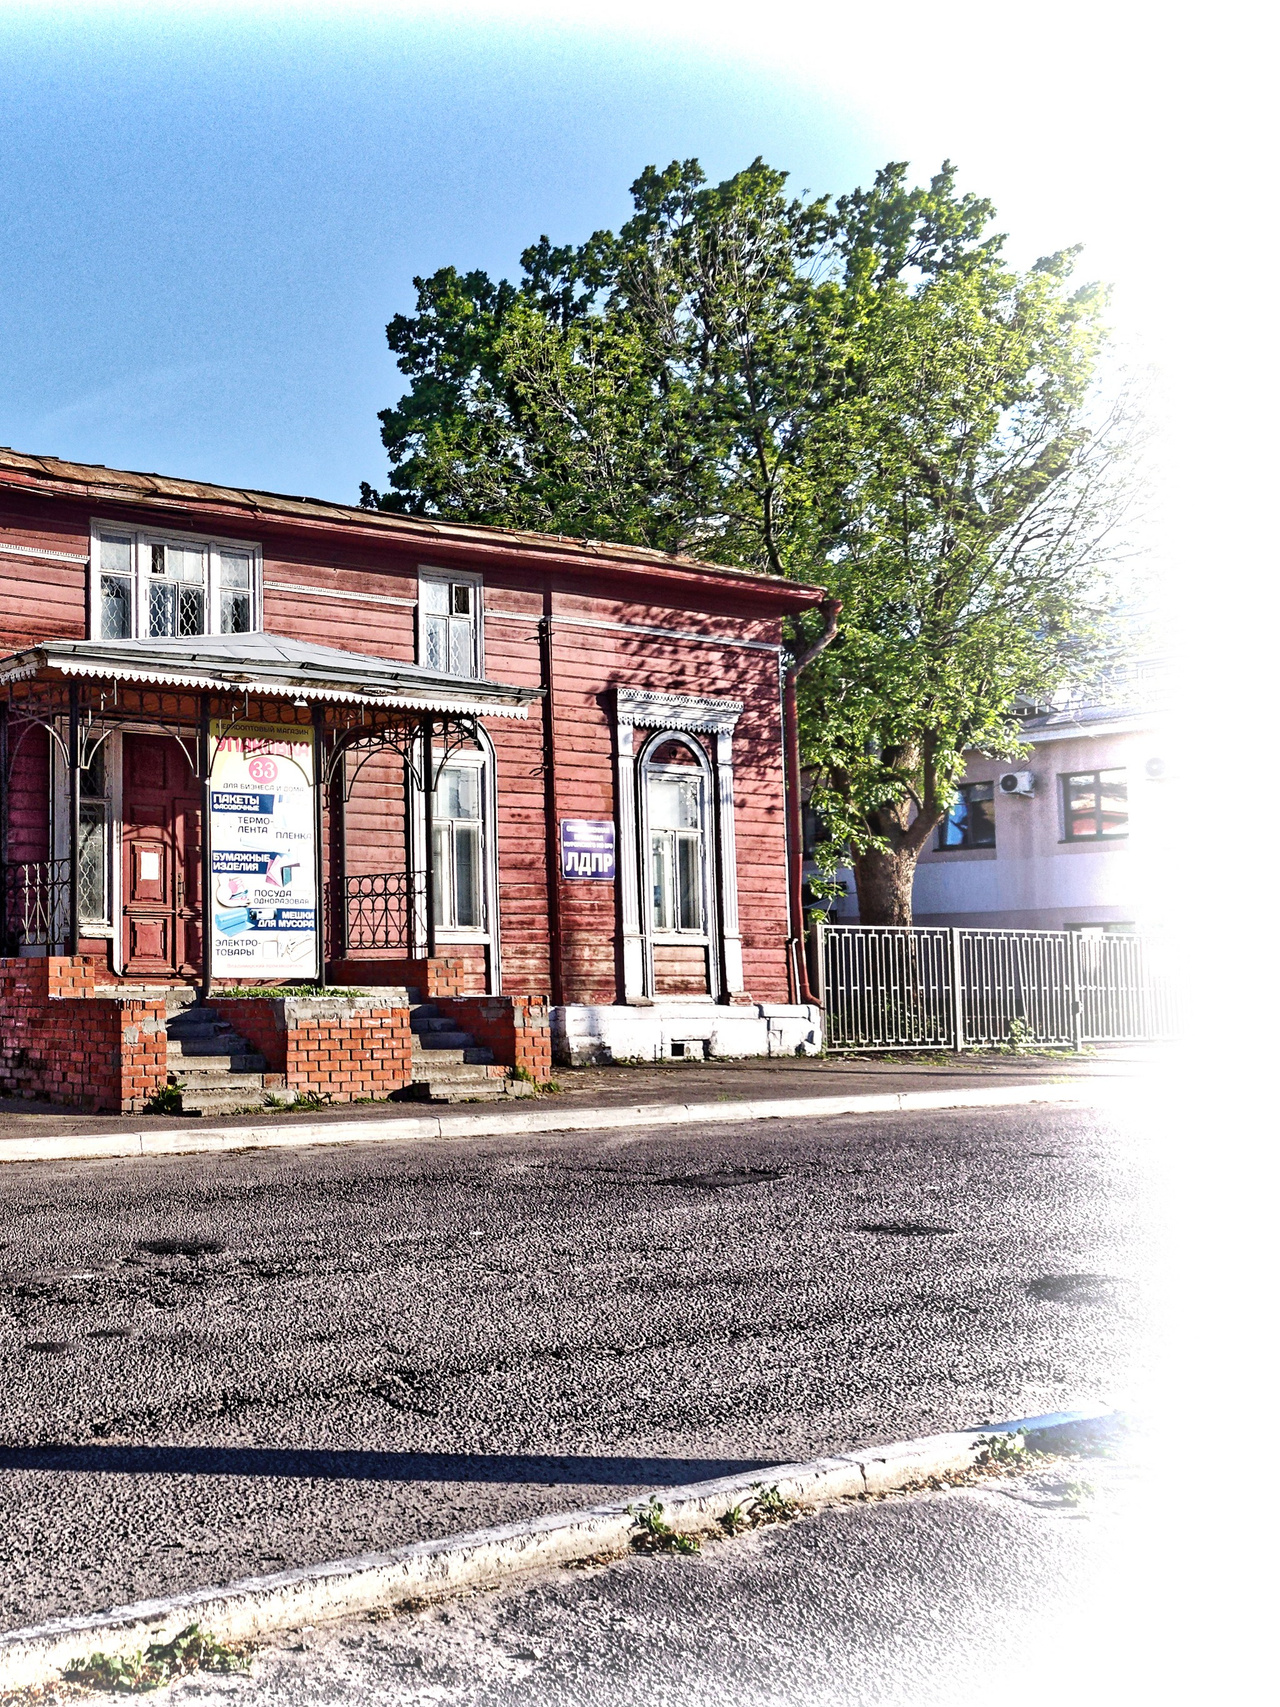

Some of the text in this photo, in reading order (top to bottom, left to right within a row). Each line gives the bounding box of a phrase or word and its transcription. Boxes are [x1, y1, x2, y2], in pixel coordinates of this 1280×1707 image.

[277, 727, 309, 735] МАГАЗИН
[215, 735, 309, 757] УПАКОВКА
[252, 761, 275, 779] 33
[213, 793, 259, 805] ПАКЕТЫ
[213, 803, 259, 811] ФАСОВОЧНЫЕ
[238, 816, 274, 825] ТЕРМО-
[238, 826, 268, 834] ЛЕНТА
[276, 832, 312, 840] ПЛЕНКА
[213, 852, 270, 862] БУМАЖНЫЕ
[213, 862, 259, 871] ИЗДЕЛИЯ
[566, 851, 613, 876] ЛДПР
[254, 889, 292, 898] ПОСУДА
[281, 911, 315, 919] МЕШКИ
[257, 920, 315, 928] ДЛЯ МУСОРА
[215, 939, 261, 947] ЭЛЕКТРО-
[216, 948, 254, 956] ТОВАРЫ
